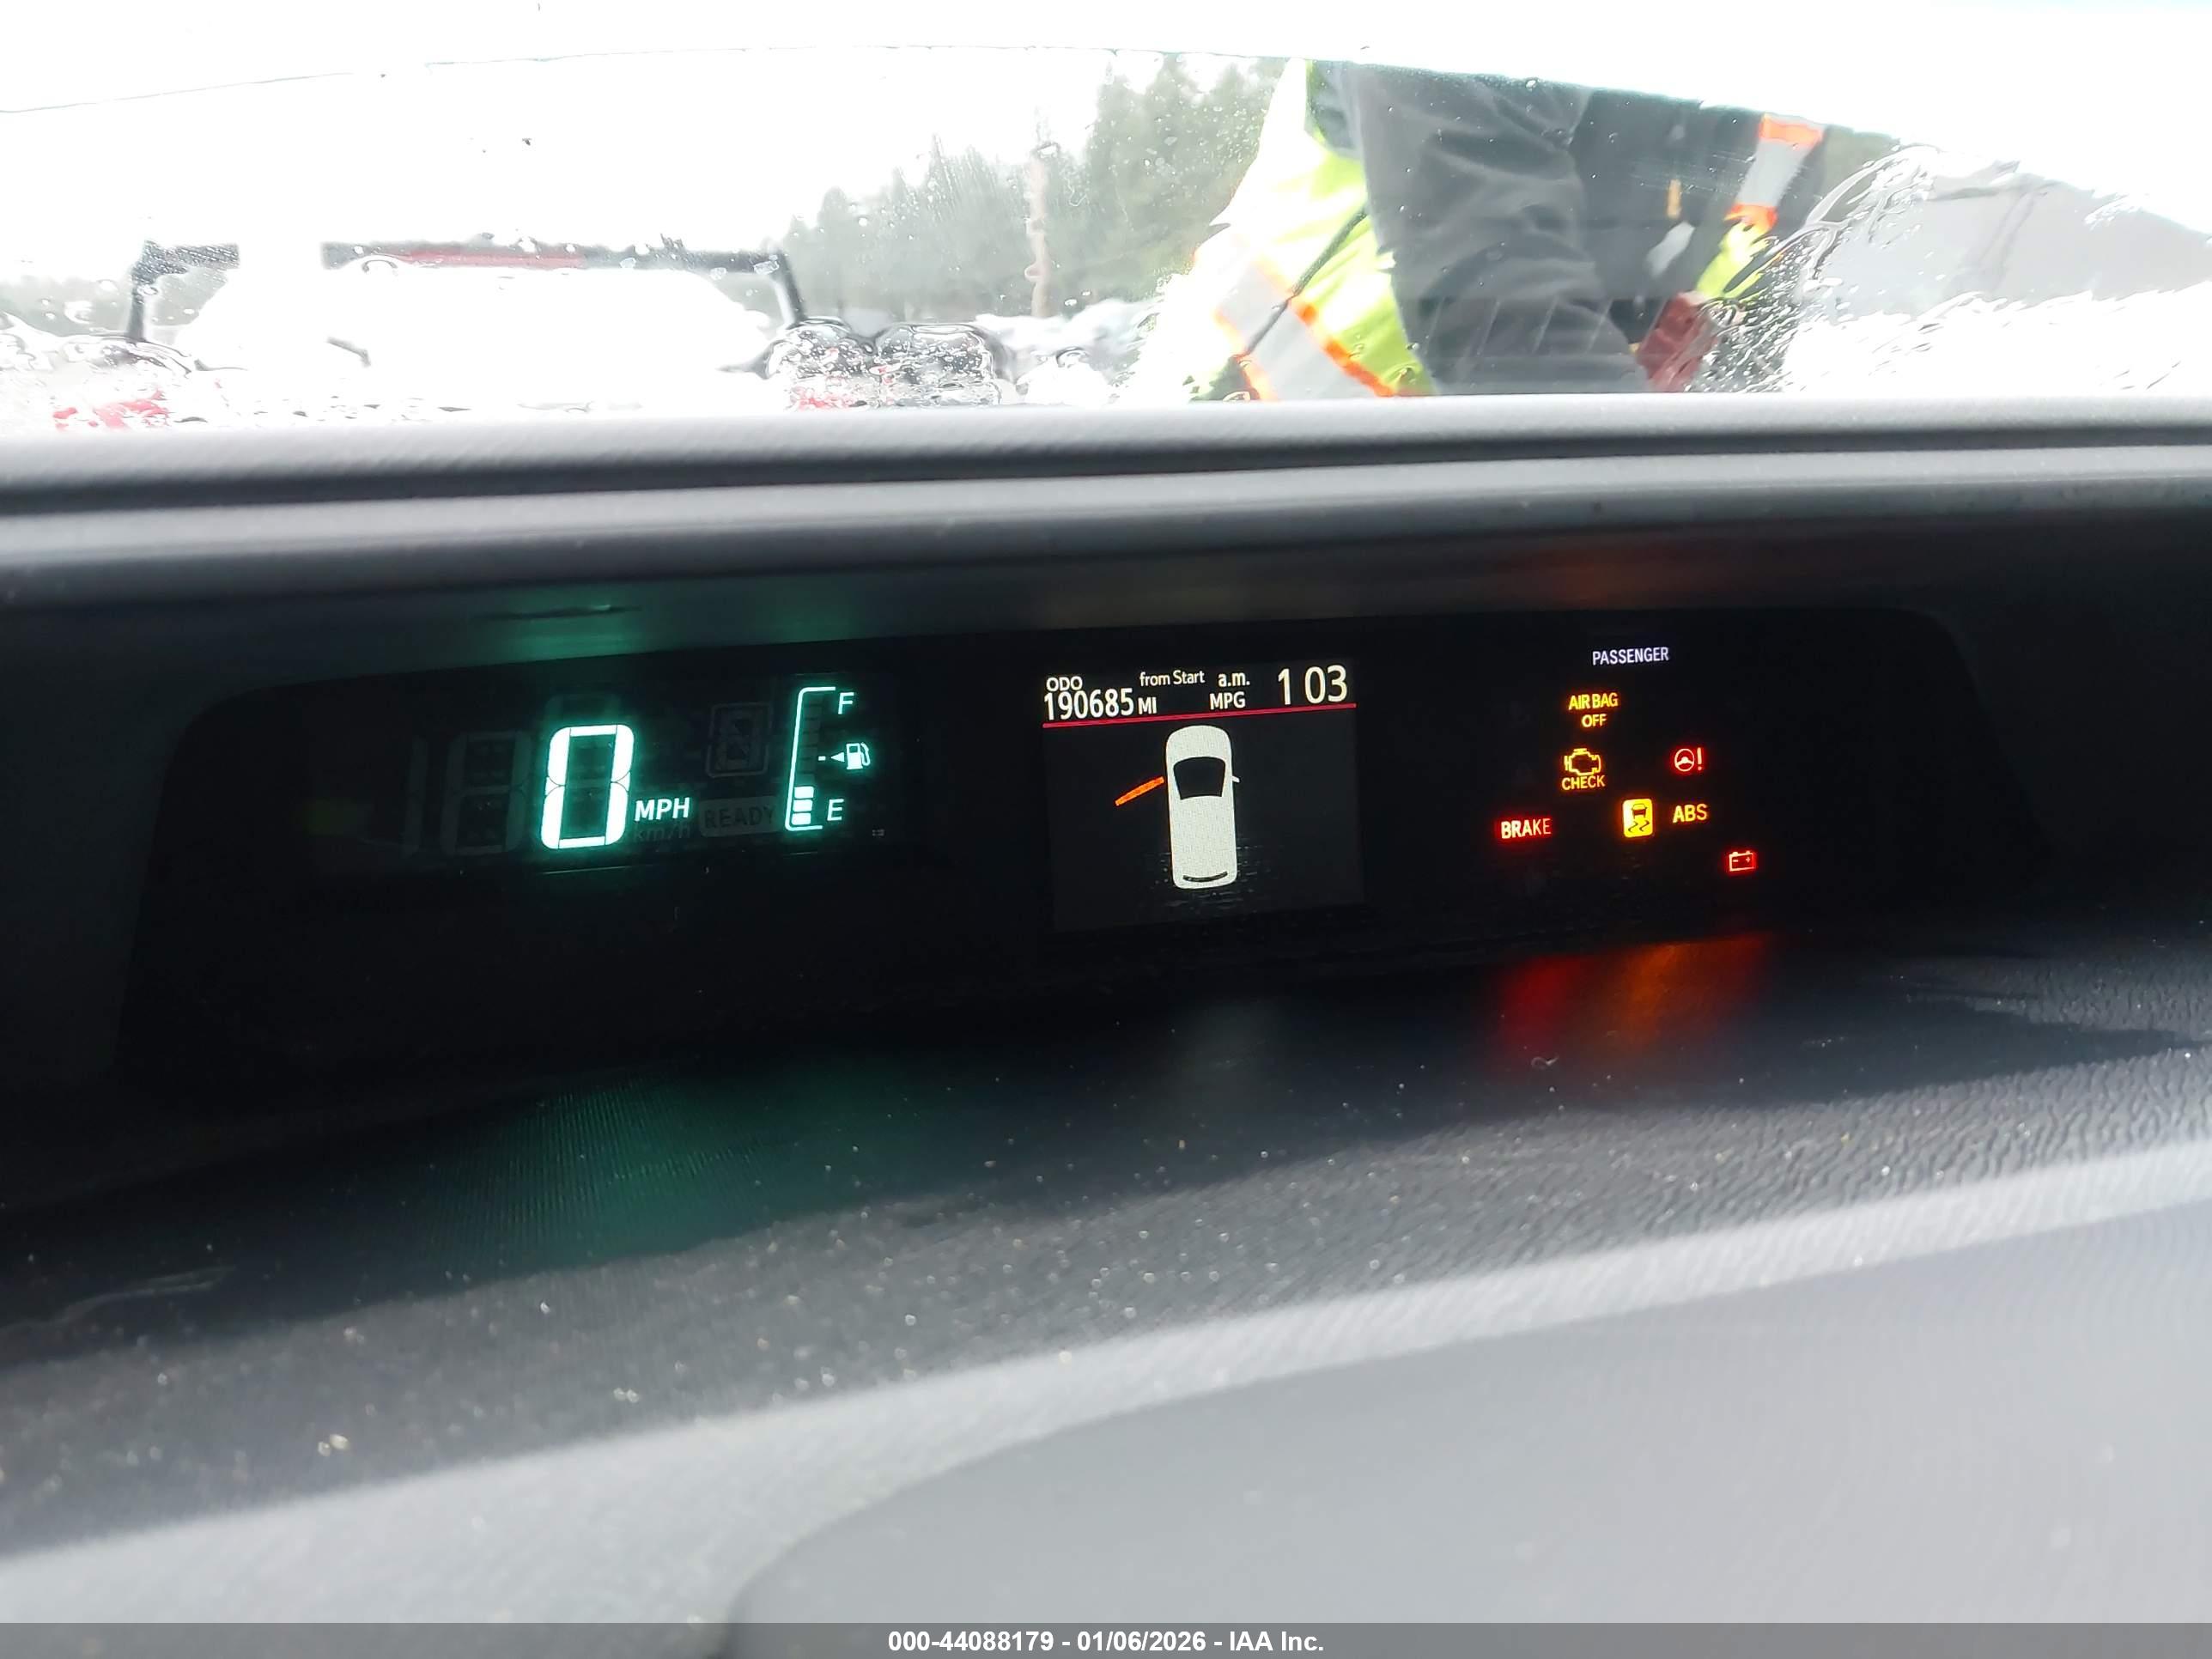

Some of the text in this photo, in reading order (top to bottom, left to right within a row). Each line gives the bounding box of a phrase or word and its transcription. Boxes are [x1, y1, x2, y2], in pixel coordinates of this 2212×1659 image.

[1593, 647, 1668, 665] PASSENGER
[1046, 676, 1083, 692] ODO
[1139, 670, 1205, 686] from Start
[1218, 673, 1249, 687] a.m.
[838, 692, 854, 714] F
[1043, 688, 1157, 720] 190685 MI
[1209, 692, 1245, 710] MPG
[1582, 714, 1607, 727] OFF
[541, 725, 690, 848] 0 MPH
[1561, 775, 1605, 790] CHECK
[705, 805, 775, 828] READY
[827, 799, 844, 821] E
[1673, 804, 1707, 823] ABS
[1501, 818, 1552, 839] BRAKE
